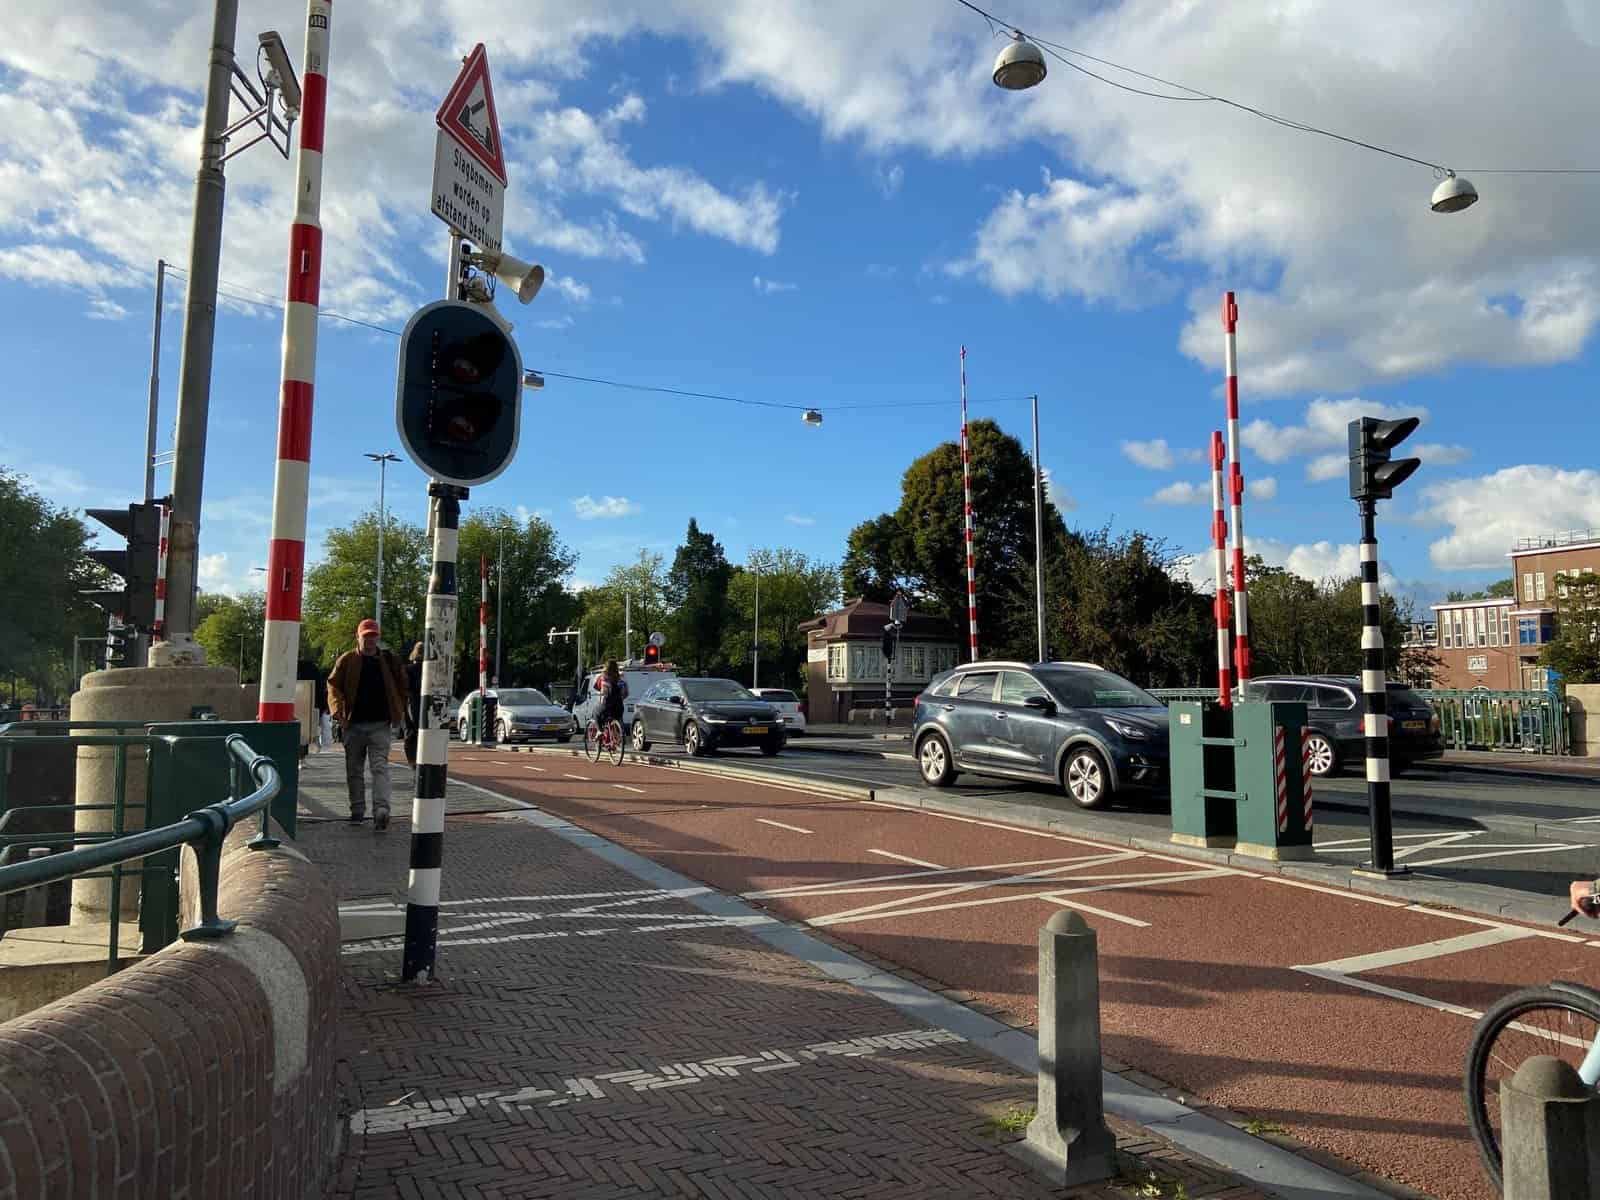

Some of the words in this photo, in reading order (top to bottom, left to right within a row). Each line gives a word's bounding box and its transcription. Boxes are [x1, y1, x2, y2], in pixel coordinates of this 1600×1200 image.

[454, 149, 493, 197] Slagbomen
[436, 195, 467, 229] afstand
[453, 182, 480, 212] worden
[482, 205, 490, 223] op
